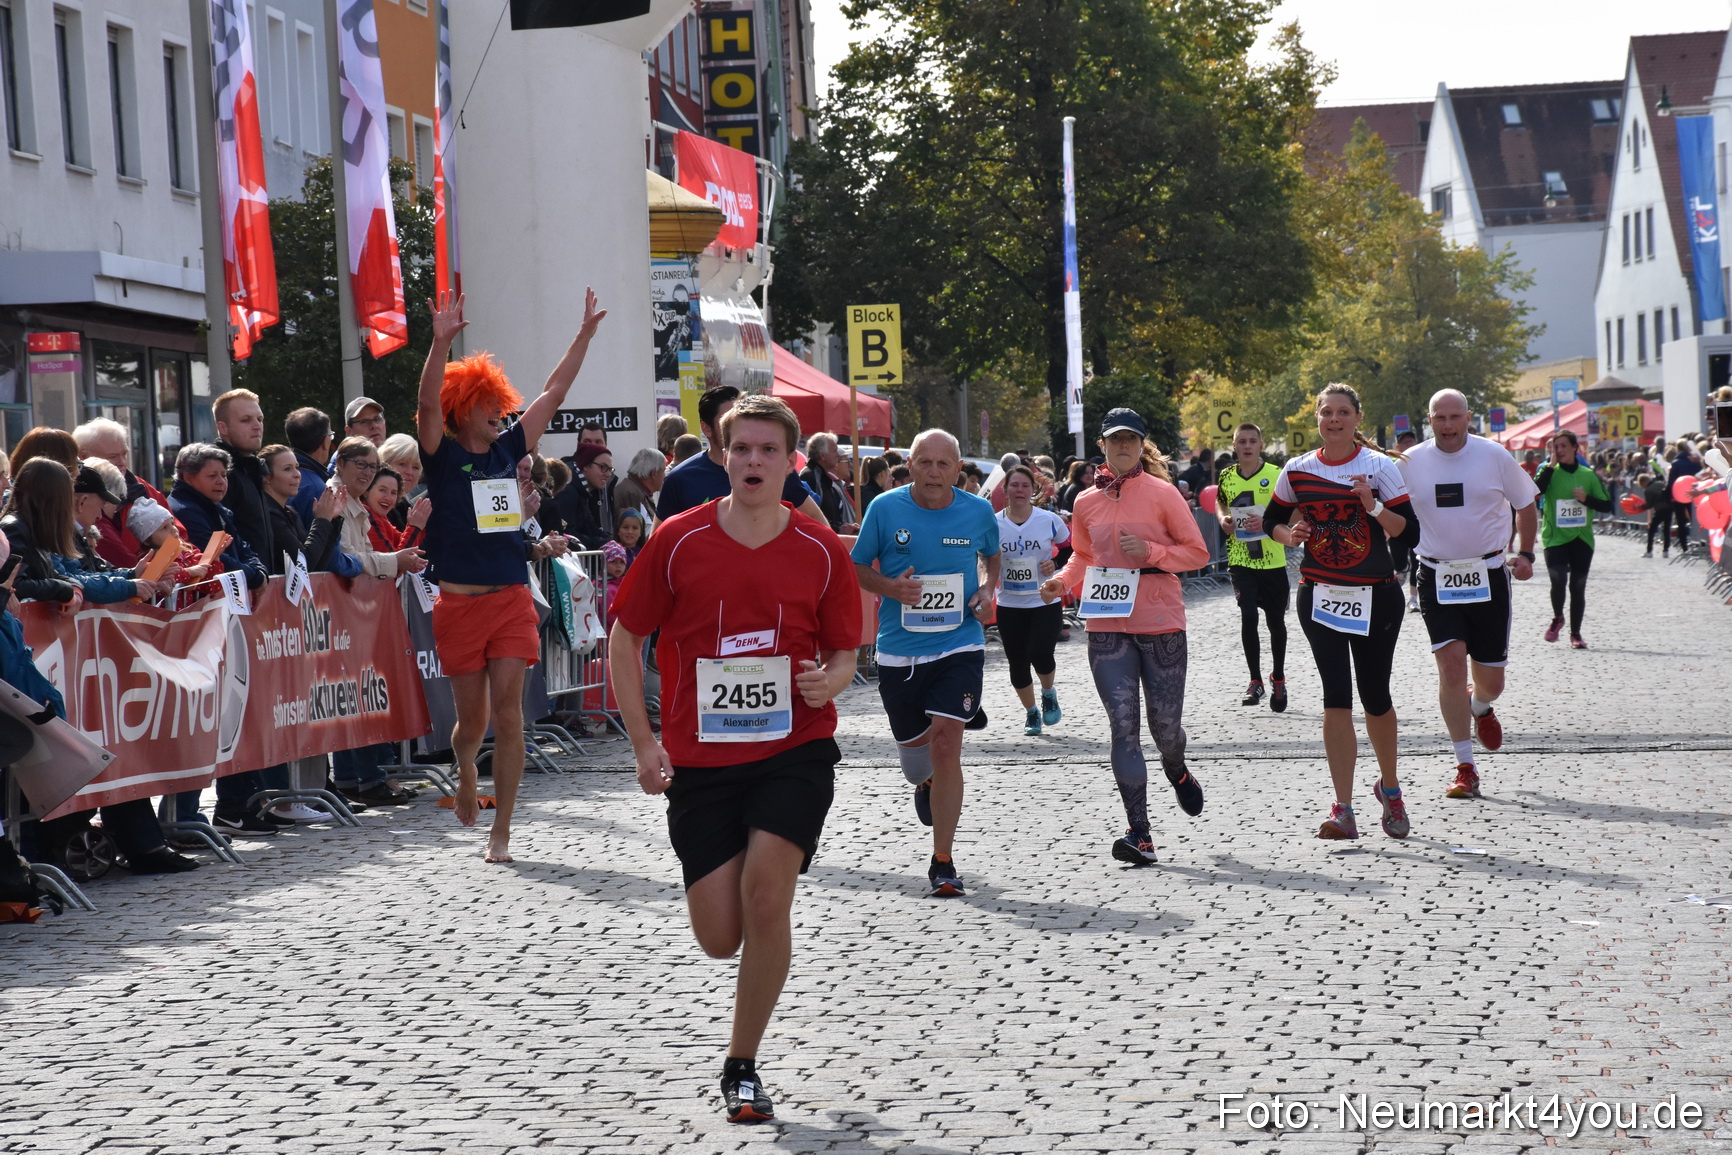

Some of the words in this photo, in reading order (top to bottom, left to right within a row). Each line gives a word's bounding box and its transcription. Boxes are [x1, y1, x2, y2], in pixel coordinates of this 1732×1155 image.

[853, 308, 894, 323] Block
[861, 329, 889, 367] B
[1213, 399, 1236, 407] Block
[1217, 410, 1233, 432] C
[1627, 415, 1639, 430] D
[1293, 432, 1305, 447] D
[492, 496, 509, 511] 35
[1561, 507, 1583, 517] 2185
[1001, 538, 1041, 553] SUSPA
[1006, 569, 1032, 580] 2069
[1443, 572, 1481, 588] 2048
[1090, 584, 1130, 600] 2039
[1321, 599, 1362, 617] 2726
[302, 598, 331, 654] 80er
[922, 615, 945, 623] Ludwig
[735, 637, 760, 648] DEHN
[361, 665, 388, 713] Hits
[712, 682, 778, 709] 2455
[722, 718, 769, 727] Alexander
